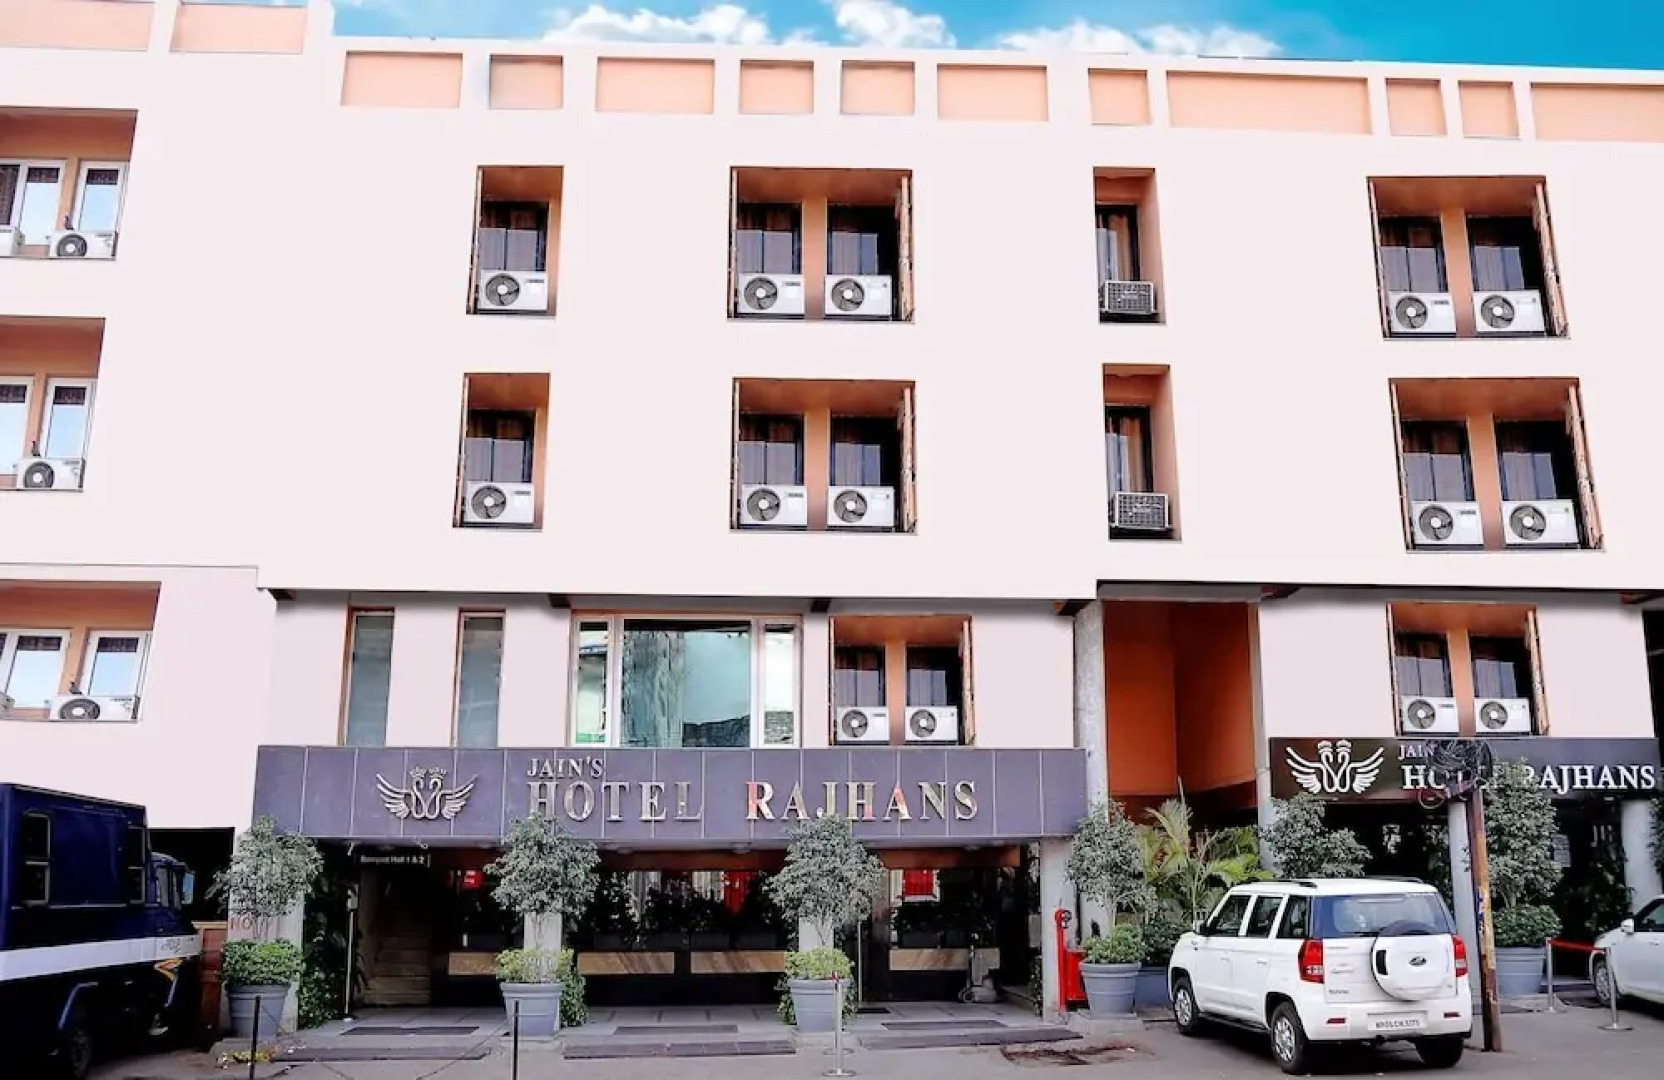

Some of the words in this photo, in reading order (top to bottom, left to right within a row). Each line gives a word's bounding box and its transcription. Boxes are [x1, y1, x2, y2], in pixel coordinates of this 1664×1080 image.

[527, 756, 603, 778] JAIN'S
[527, 781, 703, 821] HOTEL
[745, 781, 978, 820] RAJHANS
